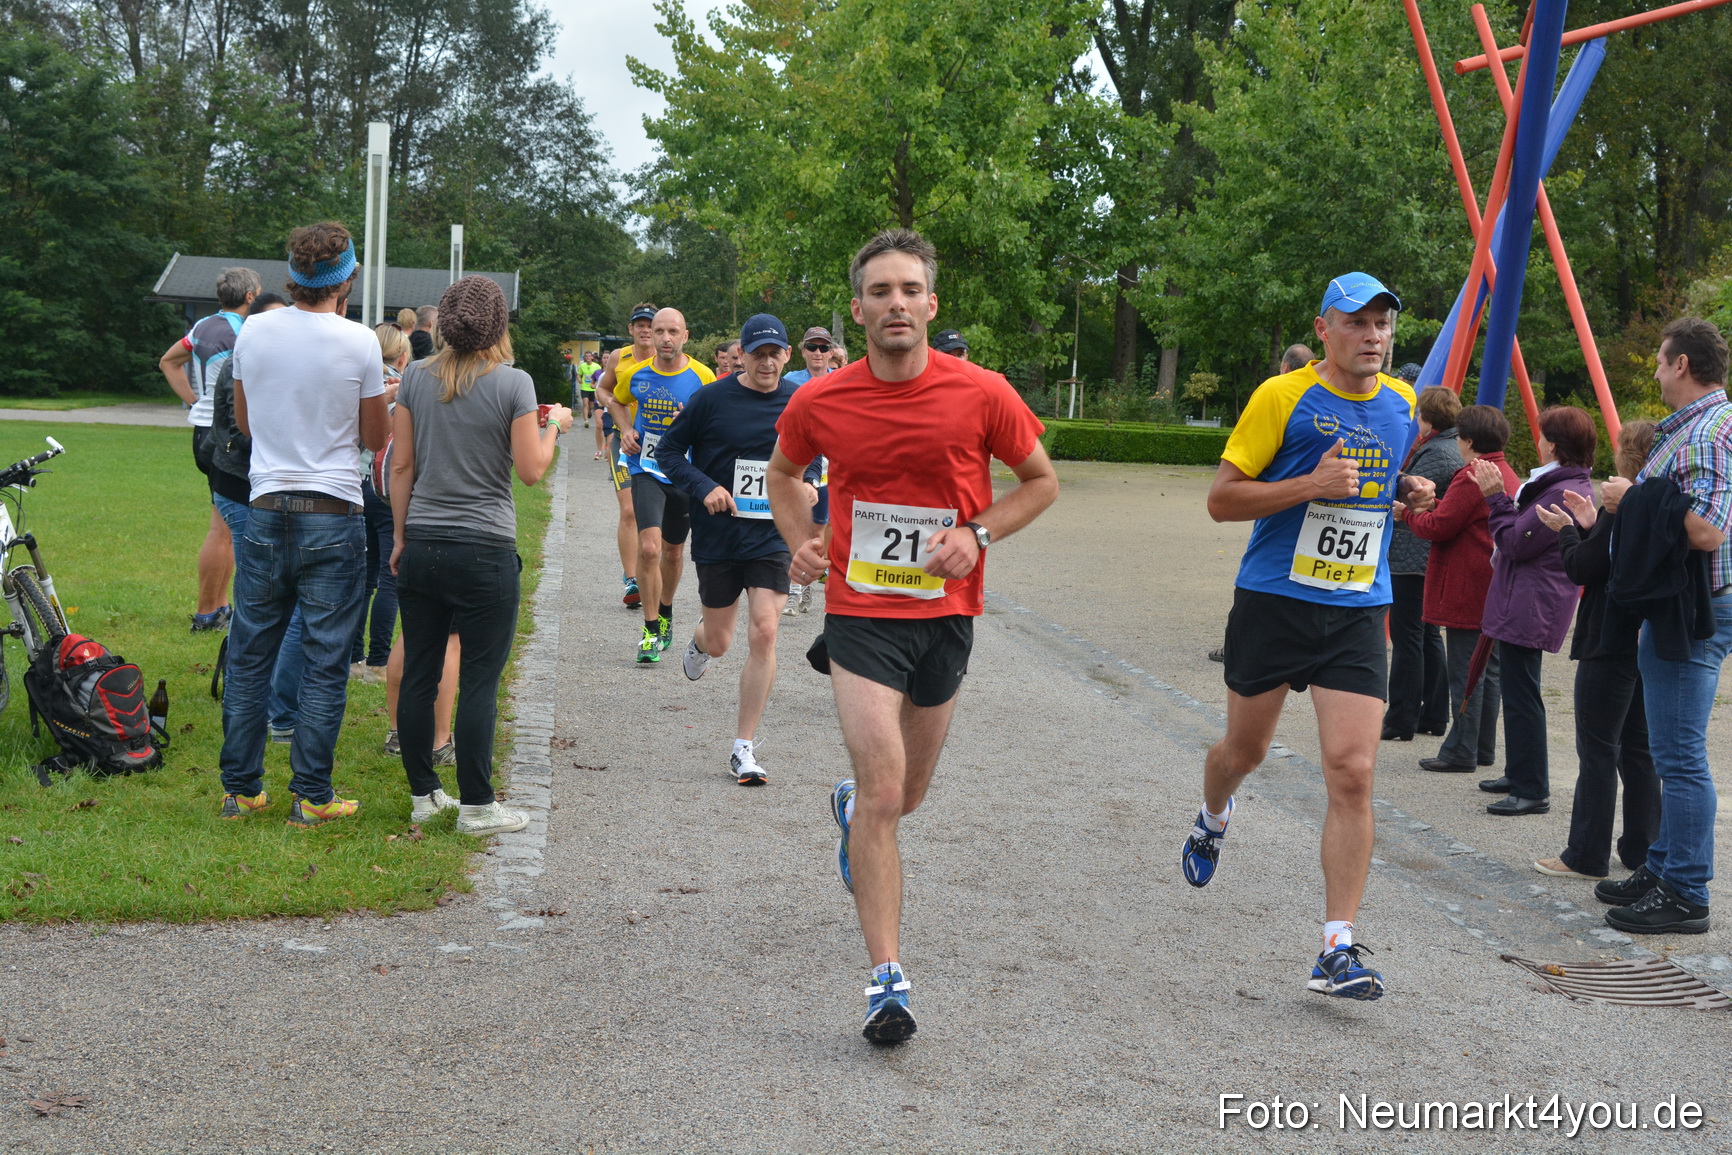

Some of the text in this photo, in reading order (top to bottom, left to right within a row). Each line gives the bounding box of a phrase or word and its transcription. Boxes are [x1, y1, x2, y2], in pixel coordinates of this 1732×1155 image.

[646, 443, 655, 459] 2
[740, 474, 764, 496] 21
[854, 509, 938, 526] PARTL Neumarkt
[1307, 511, 1376, 528] PARTL Neumarkt
[880, 527, 920, 563] 21
[1317, 526, 1370, 562] 654
[875, 569, 921, 585] Florian
[1311, 559, 1355, 581] Piet
